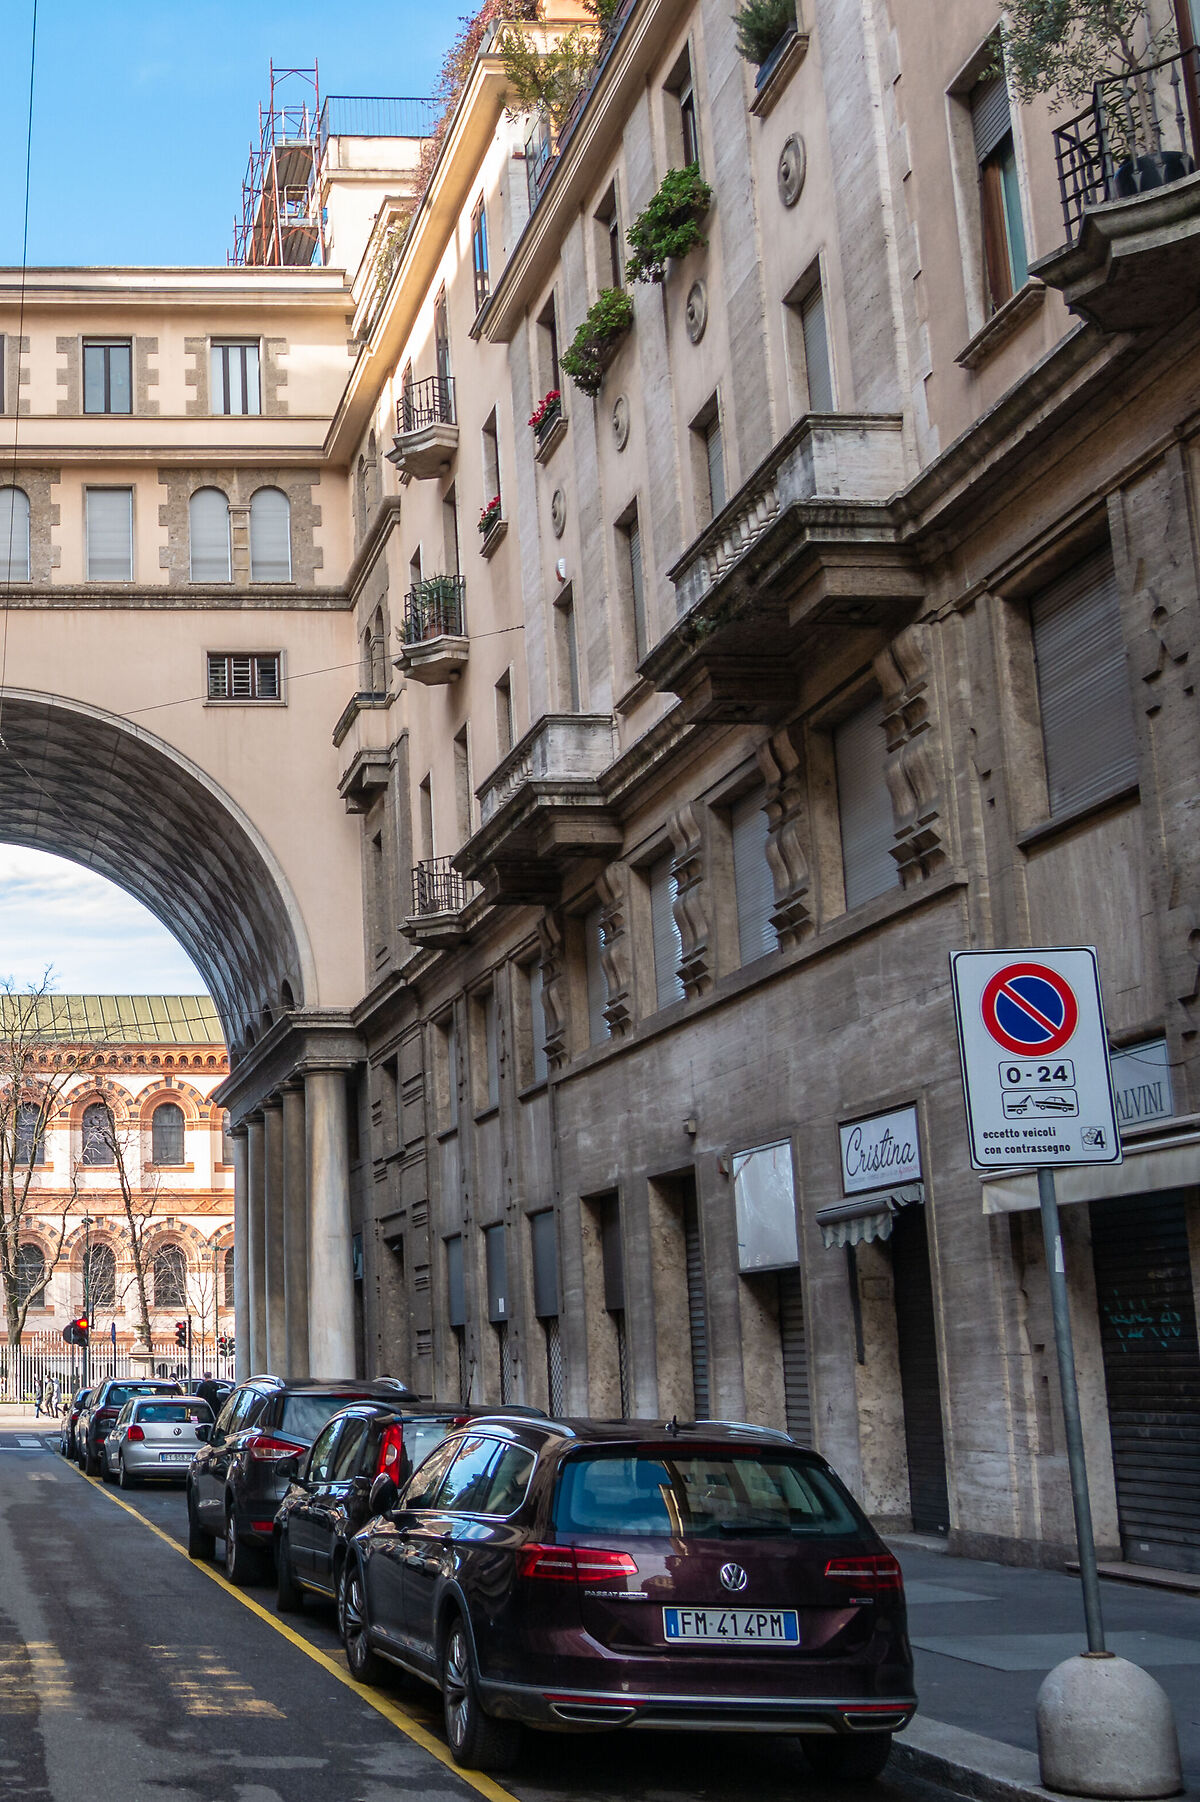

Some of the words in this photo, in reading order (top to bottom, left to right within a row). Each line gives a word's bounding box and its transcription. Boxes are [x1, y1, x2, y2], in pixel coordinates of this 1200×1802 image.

[983, 1128, 1020, 1139] eccetto
[1022, 1126, 1056, 1137] veicoli
[846, 1127, 916, 1176] Cristina
[984, 1146, 1002, 1155] con
[1004, 1143, 1071, 1155] contrassegno
[680, 1612, 708, 1636] FM
[717, 1613, 783, 1637] 414PM
